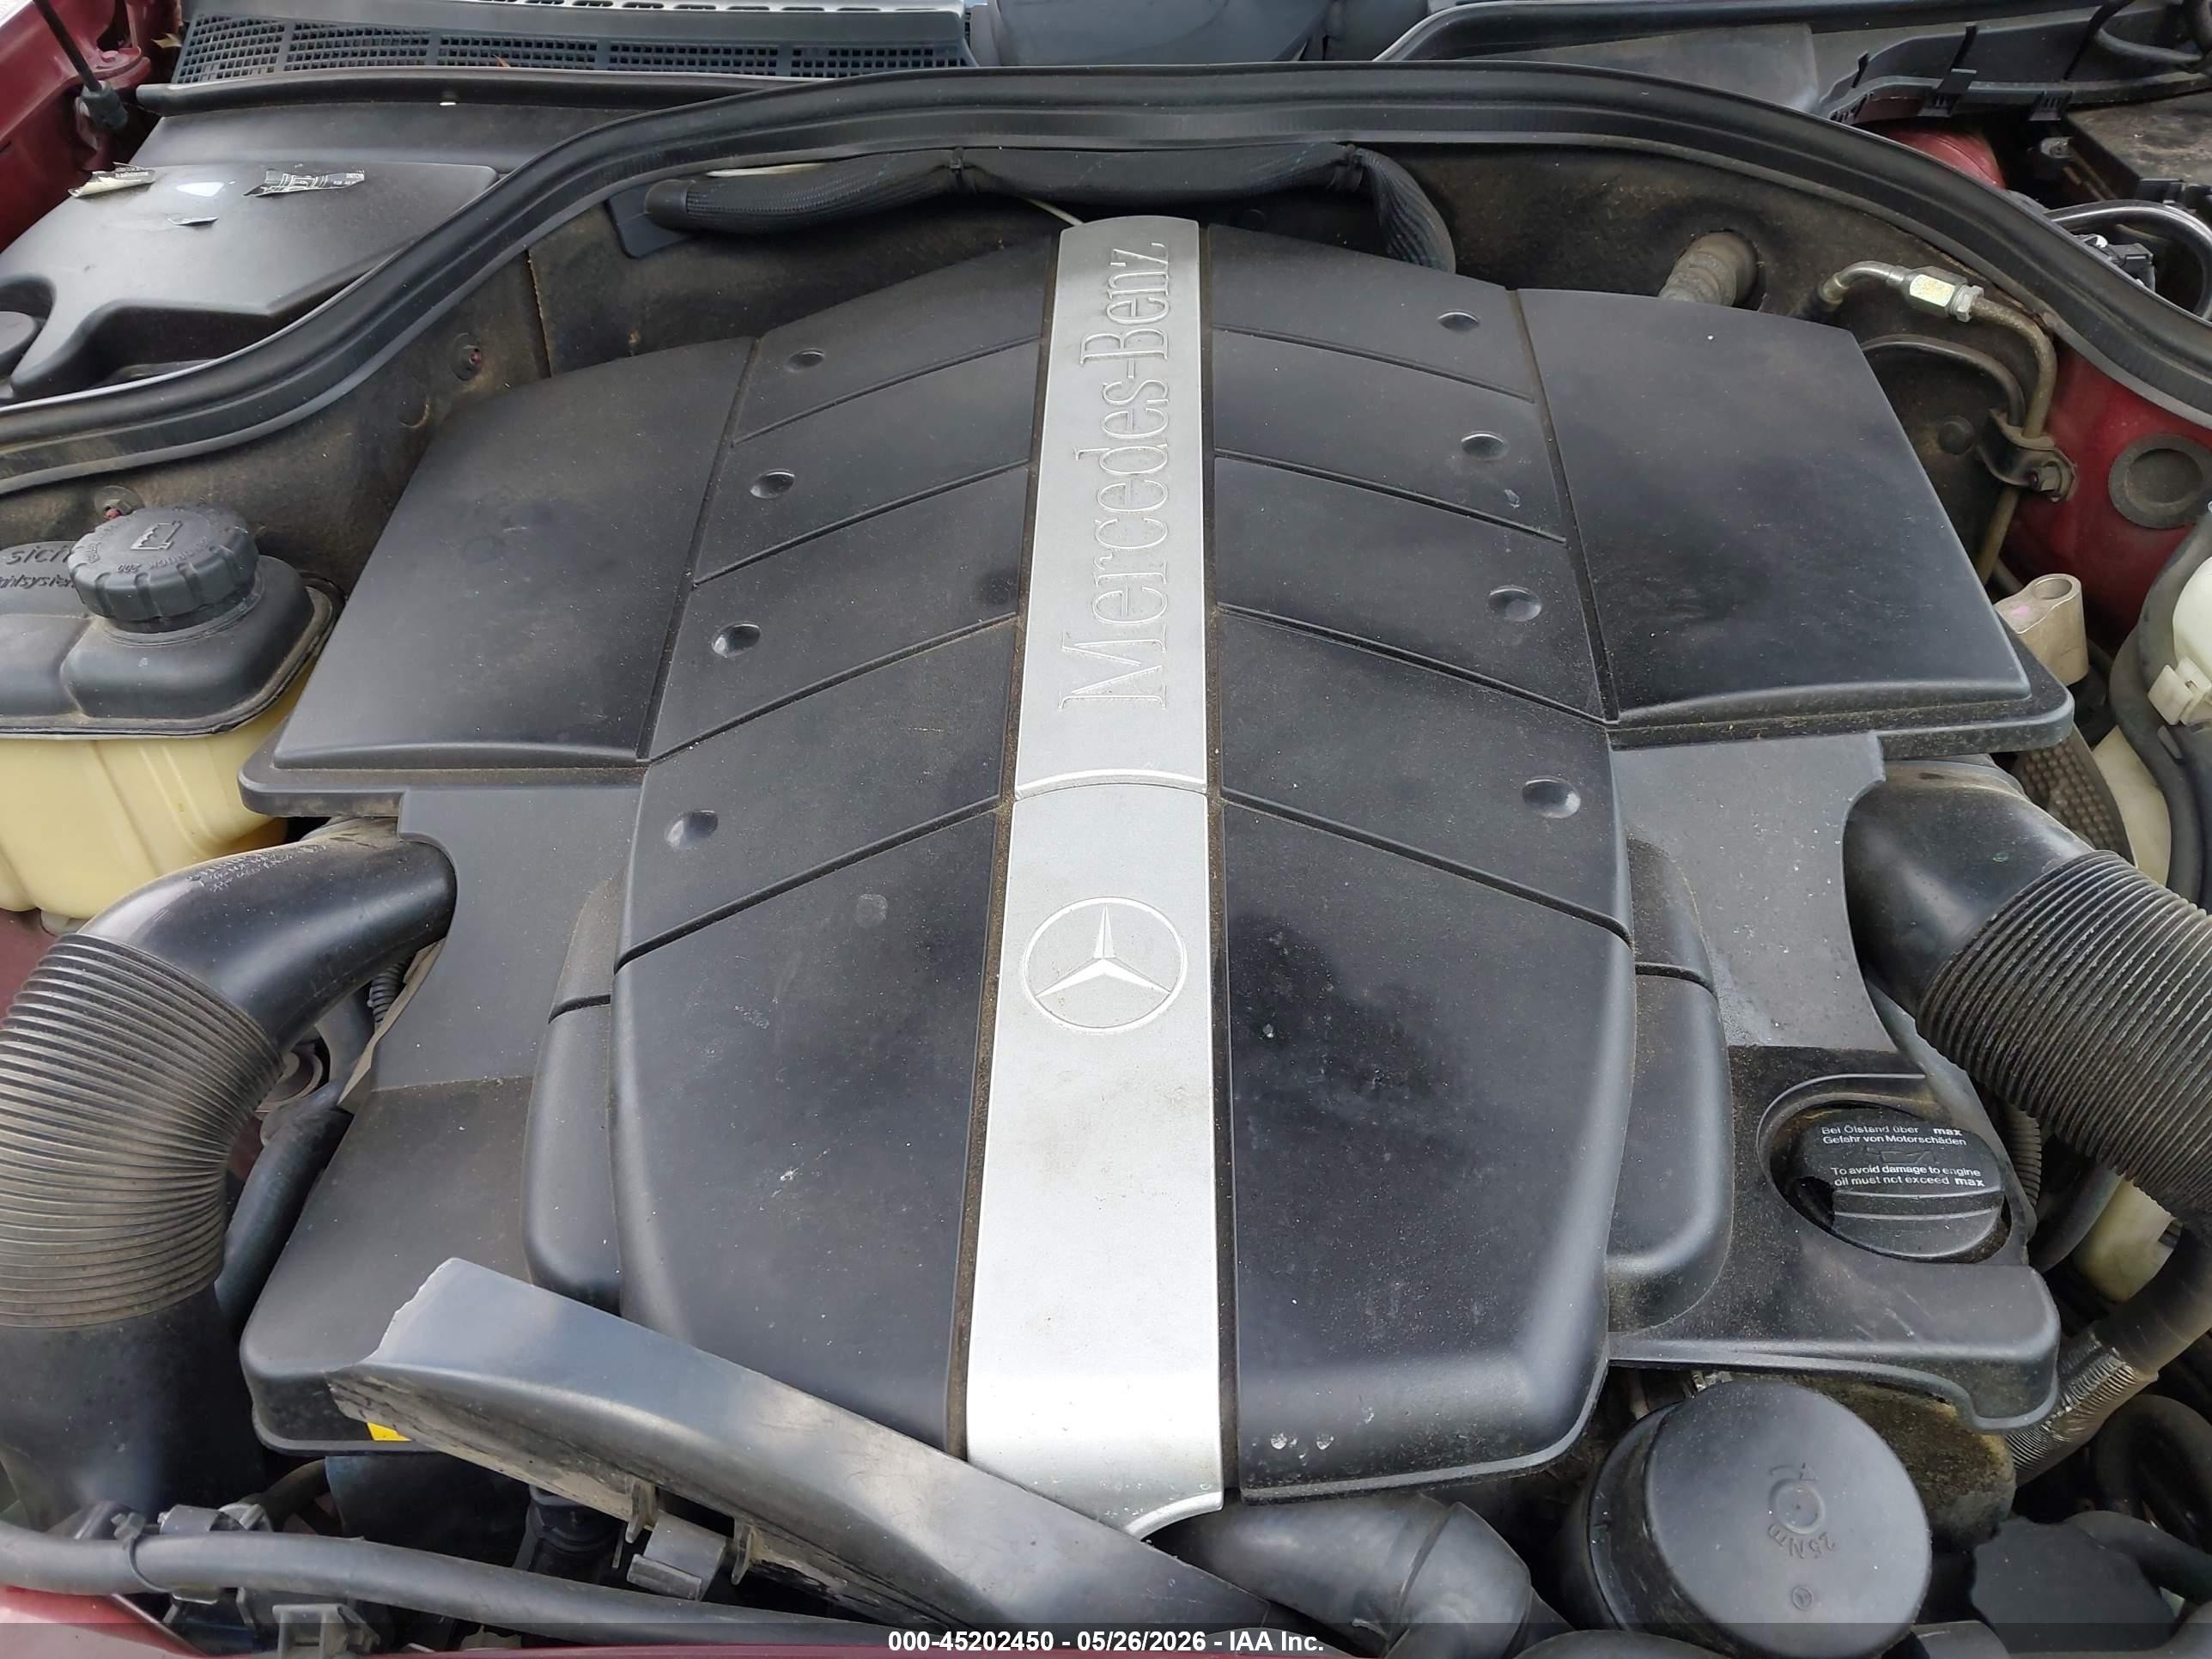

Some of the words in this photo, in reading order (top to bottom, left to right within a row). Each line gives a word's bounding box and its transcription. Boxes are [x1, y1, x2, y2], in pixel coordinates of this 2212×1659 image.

[1058, 241, 1170, 709] Mercedes-Benz
[1821, 1127, 1841, 1135] Bei
[1844, 1125, 1890, 1134] Ölstand
[1893, 1126, 1919, 1134] über
[1933, 1127, 1963, 1137] max
[1822, 1135, 1861, 1145] Gefahr
[1863, 1135, 1885, 1144] von
[1886, 1135, 1968, 1146] Motorschäden
[1831, 1166, 1847, 1176] To
[1849, 1164, 1880, 1175] avoid
[1881, 1164, 1928, 1176] damage
[1929, 1165, 1941, 1175] to
[1942, 1167, 1982, 1177] engine
[1834, 1177, 1849, 1187] oil
[1850, 1176, 1881, 1185] must
[1883, 1175, 1903, 1184] not
[1905, 1176, 1950, 1185] exceed
[1954, 1177, 1986, 1188] max
